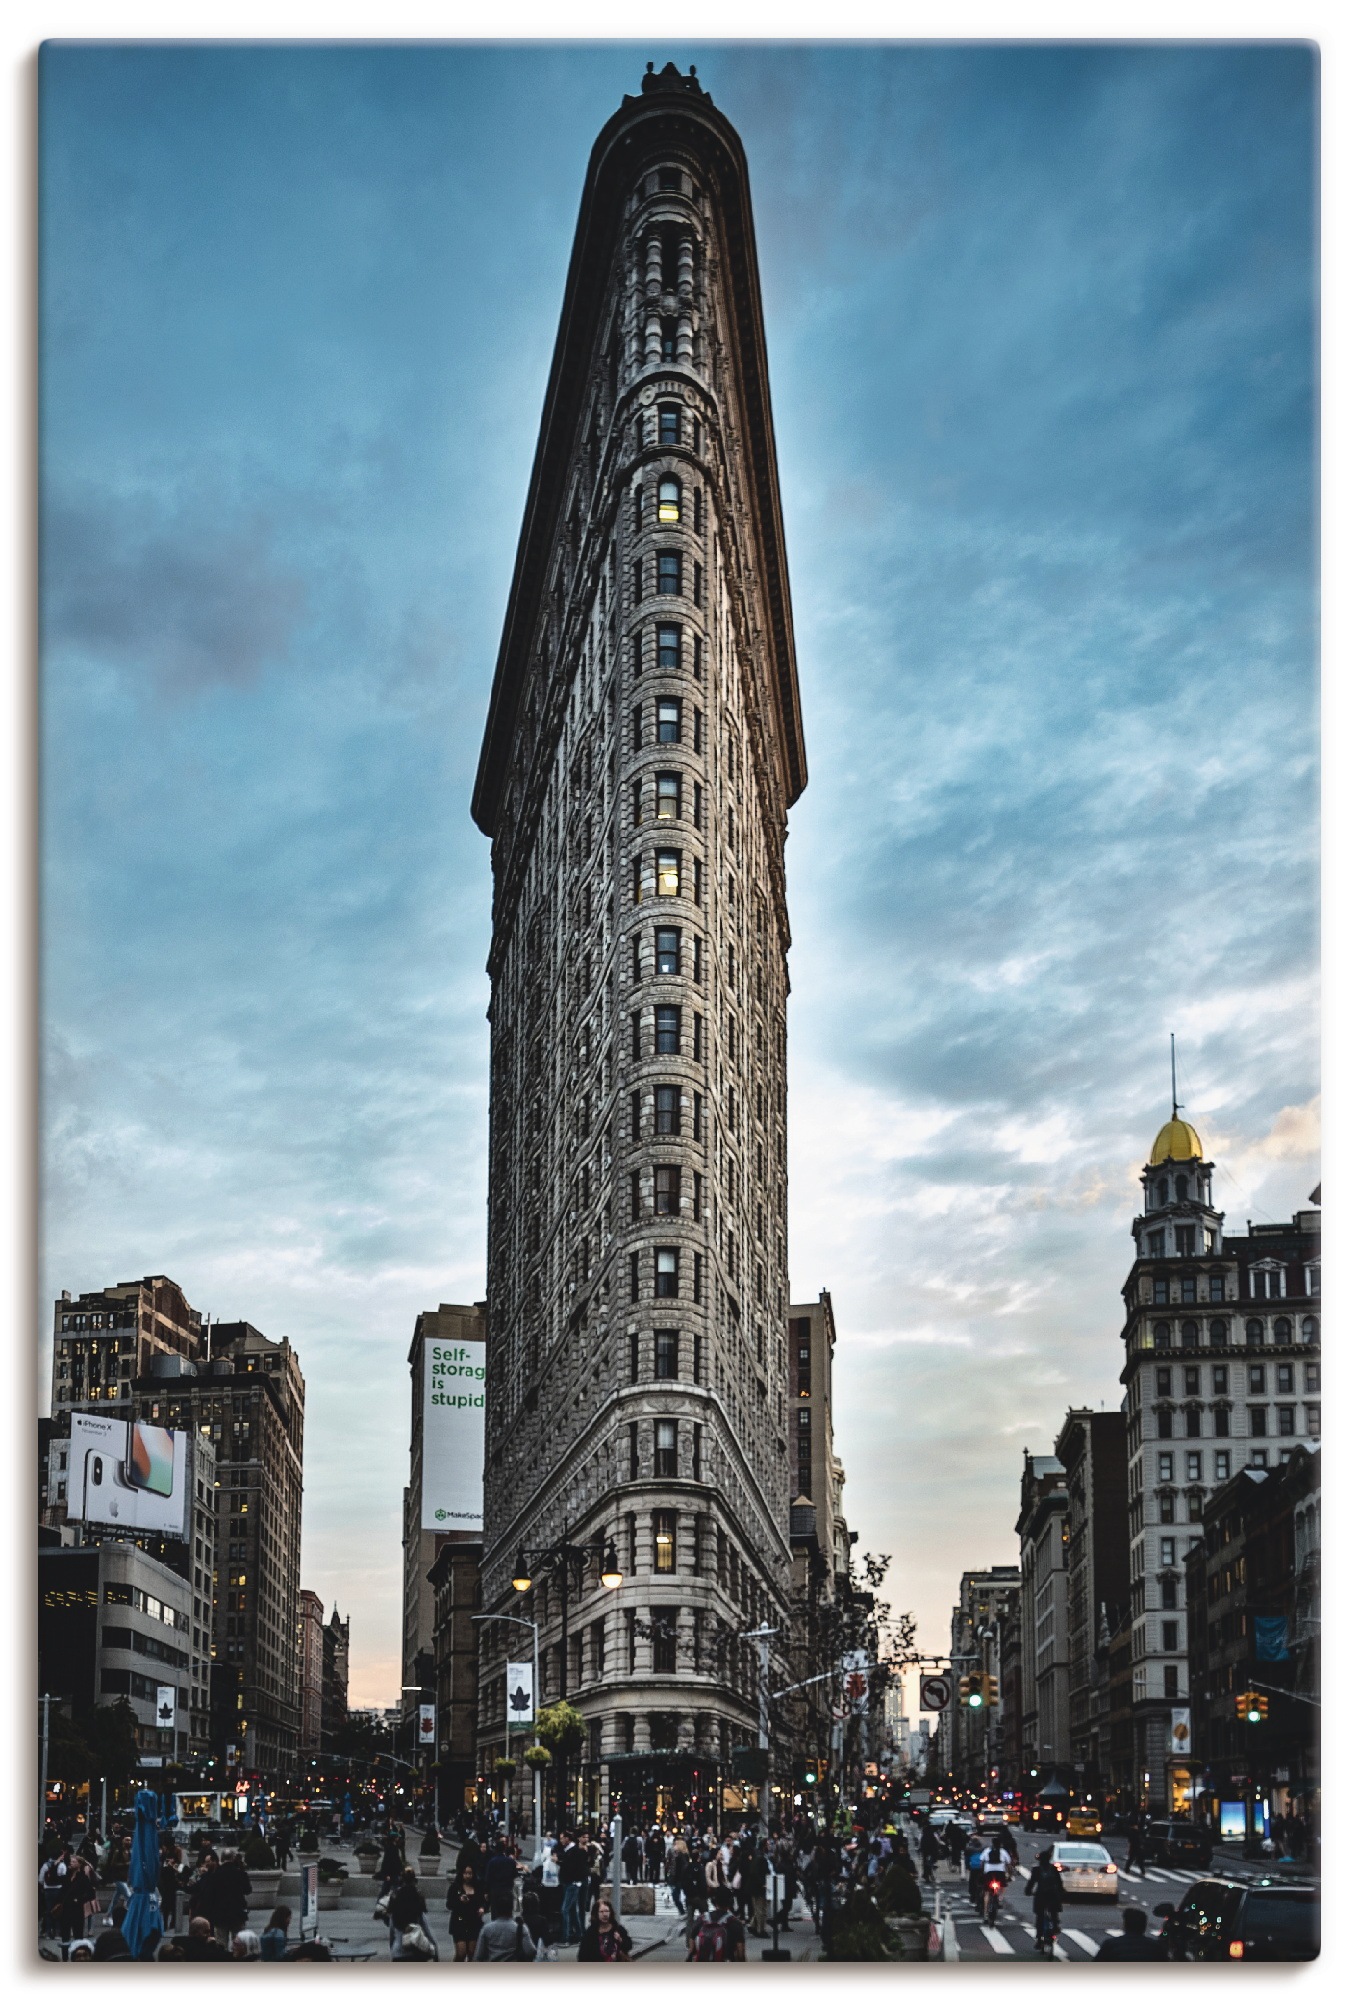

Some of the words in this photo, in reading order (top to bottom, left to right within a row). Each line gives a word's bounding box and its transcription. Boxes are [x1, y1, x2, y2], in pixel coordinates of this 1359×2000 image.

[432, 1346, 471, 1361] Self-
[432, 1376, 444, 1389] is
[431, 1392, 484, 1409] stupid
[83, 1420, 106, 1430] iPhone
